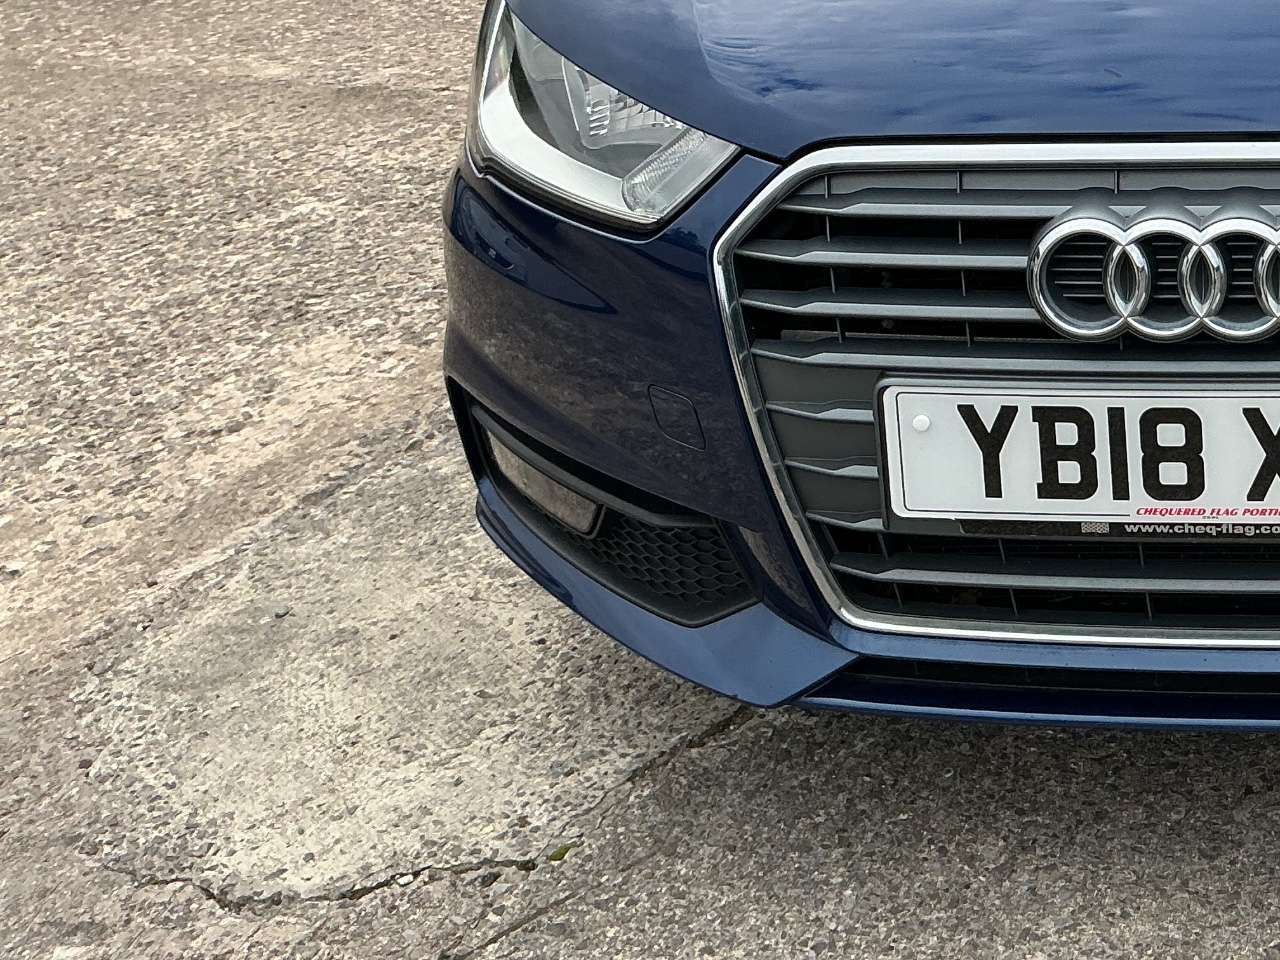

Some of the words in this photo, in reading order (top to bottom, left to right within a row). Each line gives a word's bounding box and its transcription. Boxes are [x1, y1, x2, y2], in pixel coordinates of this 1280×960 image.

[956, 404, 1206, 502] YB18
[1136, 507, 1205, 516] CHEQUERED
[1209, 507, 1239, 516] FLAG
